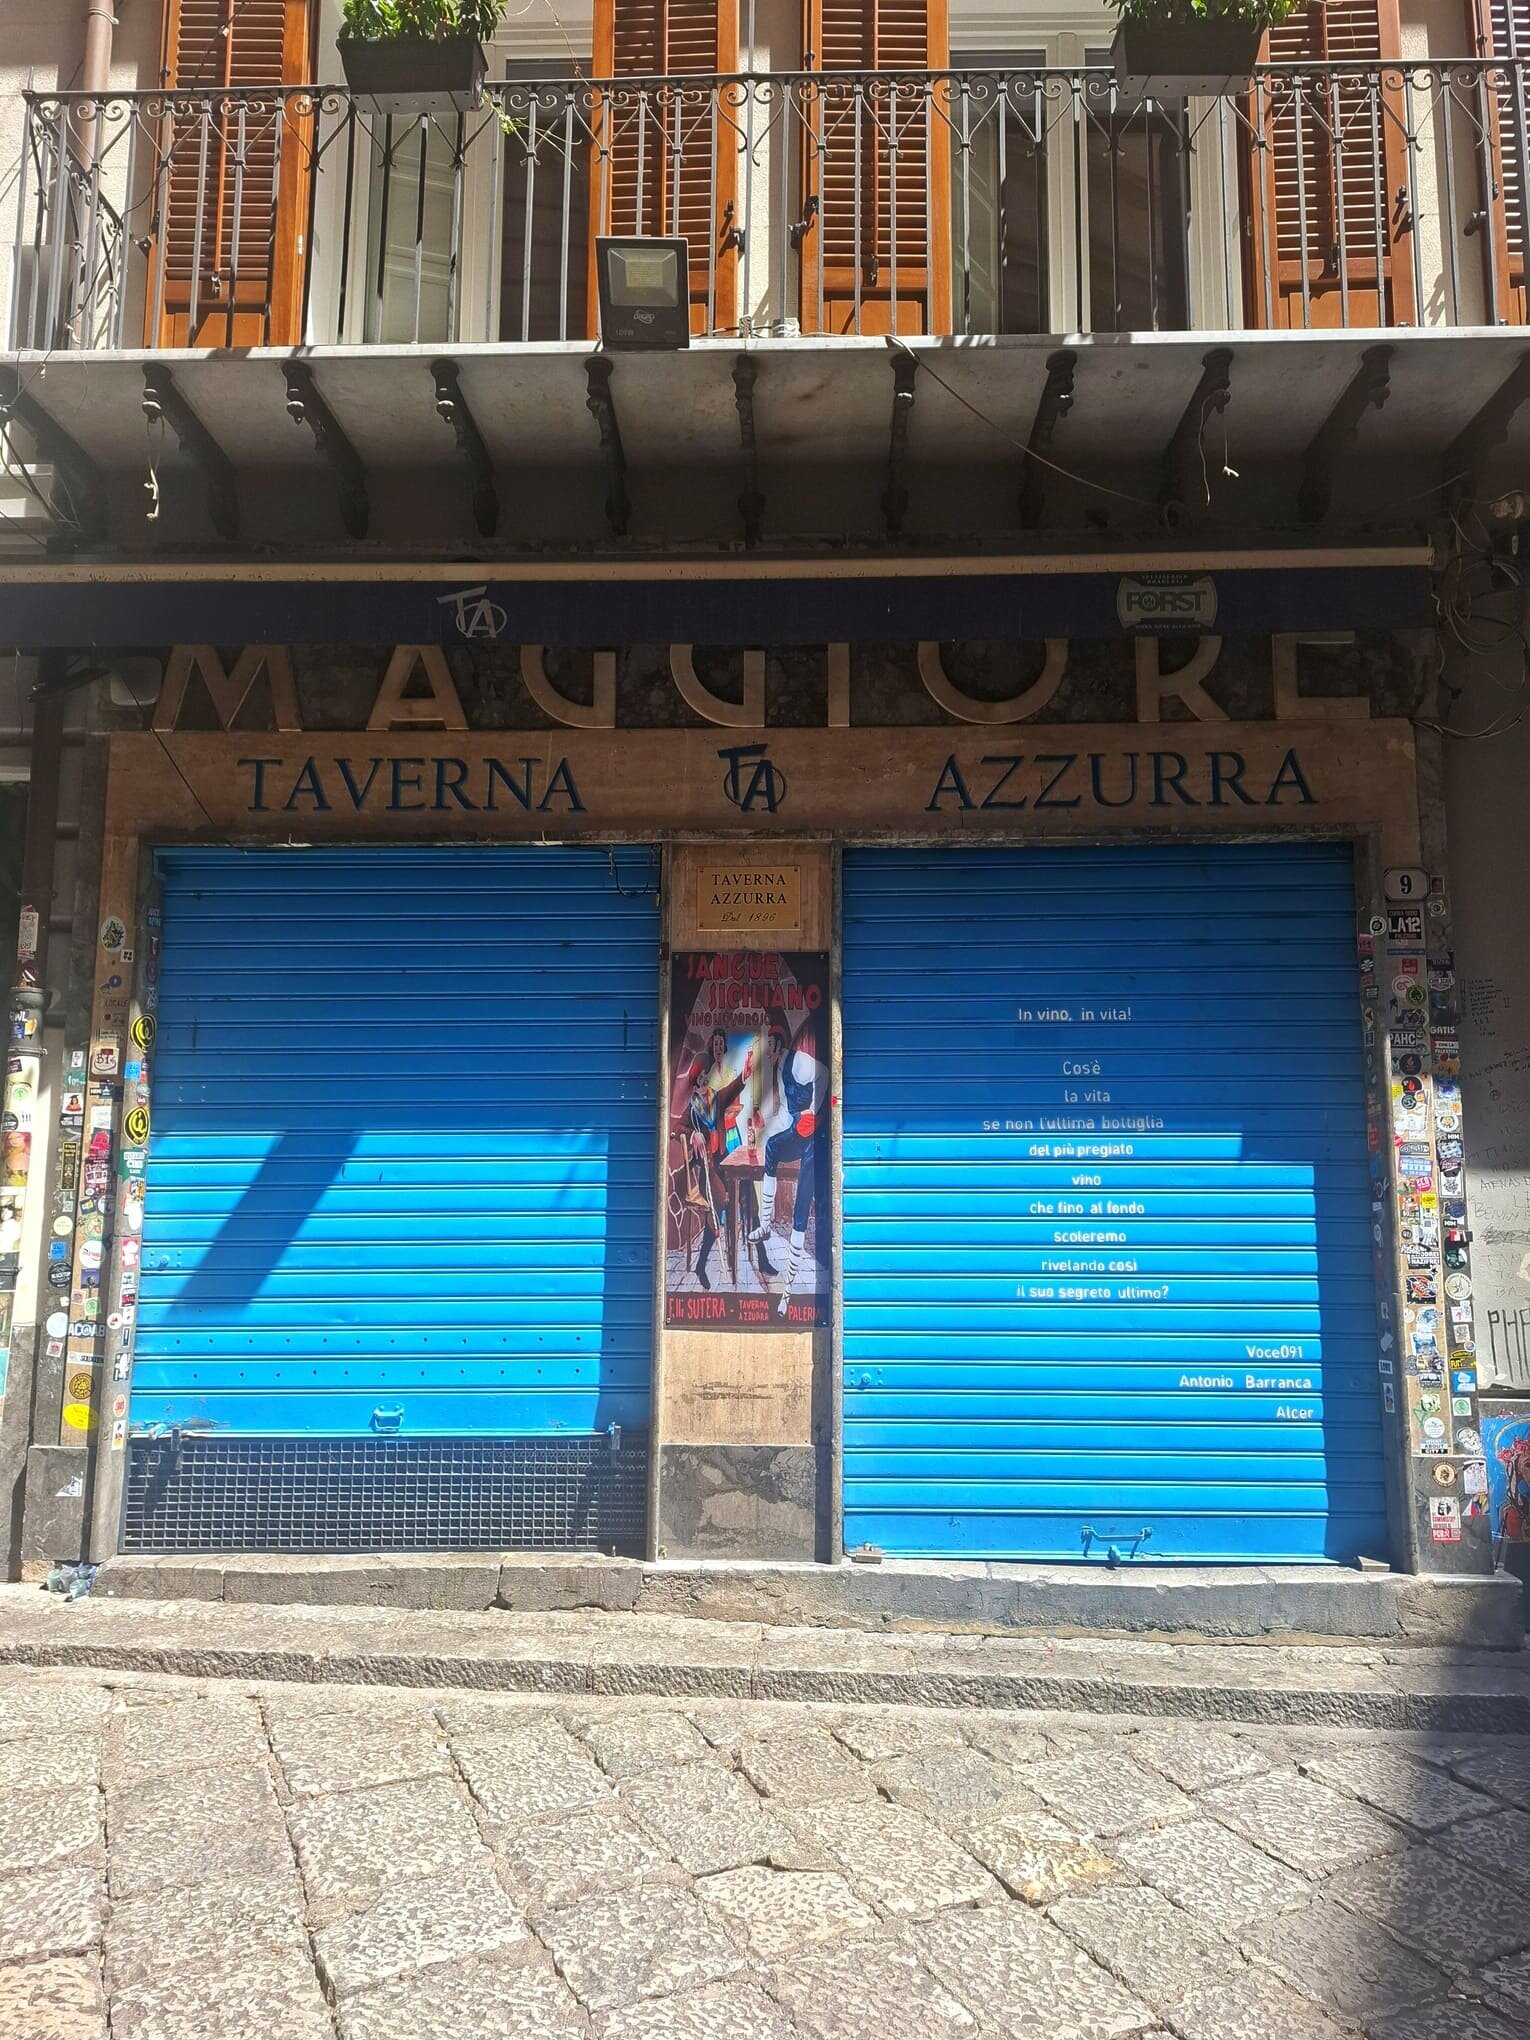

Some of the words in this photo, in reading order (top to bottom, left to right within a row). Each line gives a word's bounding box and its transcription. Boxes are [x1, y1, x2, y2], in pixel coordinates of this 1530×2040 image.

[1126, 590, 1207, 612] FORST
[236, 756, 588, 812] TAVERNA
[924, 747, 1319, 812] AZZURRA
[711, 873, 787, 886] TAVERNA
[1400, 874, 1413, 895] 9
[711, 892, 788, 905] AZZURRA
[720, 911, 742, 922] Dal
[748, 912, 777, 922] 1896
[1388, 917, 1422, 933] LA12
[708, 983, 823, 1011] SICILIANO
[1018, 1007, 1032, 1021] In
[1081, 1007, 1095, 1021] in
[1099, 1007, 1132, 1021] vita!
[1064, 1089, 1078, 1103] la
[1084, 1089, 1111, 1103] vita
[982, 1119, 1001, 1131] se
[1005, 1119, 1034, 1130] non
[1039, 1117, 1096, 1130] l'ultima
[1101, 1115, 1165, 1132] bottiglia
[1028, 1144, 1051, 1157] del
[1053, 1142, 1075, 1158] più
[1077, 1143, 1134, 1158] pregiato
[1071, 1174, 1102, 1186] vino
[1029, 1201, 1055, 1215] che
[1057, 1201, 1084, 1214] fino
[1089, 1201, 1103, 1214] al
[1106, 1201, 1145, 1215] fondo
[1053, 1230, 1127, 1243] scoleremo
[1041, 1259, 1105, 1272] rivelando
[1016, 1284, 1025, 1297] il
[1029, 1286, 1054, 1298] suo
[1058, 1285, 1112, 1300] segreto
[1118, 1285, 1170, 1299] ultimo?
[687, 1296, 727, 1320] SUTERA
[739, 1299, 769, 1310] TAVERNA
[738, 1311, 769, 1322] AZZURRA
[1245, 1344, 1304, 1359] Voce091
[1179, 1374, 1234, 1388] Antonio
[1245, 1374, 1313, 1389] Barranca
[1276, 1405, 1315, 1420] Alcer
